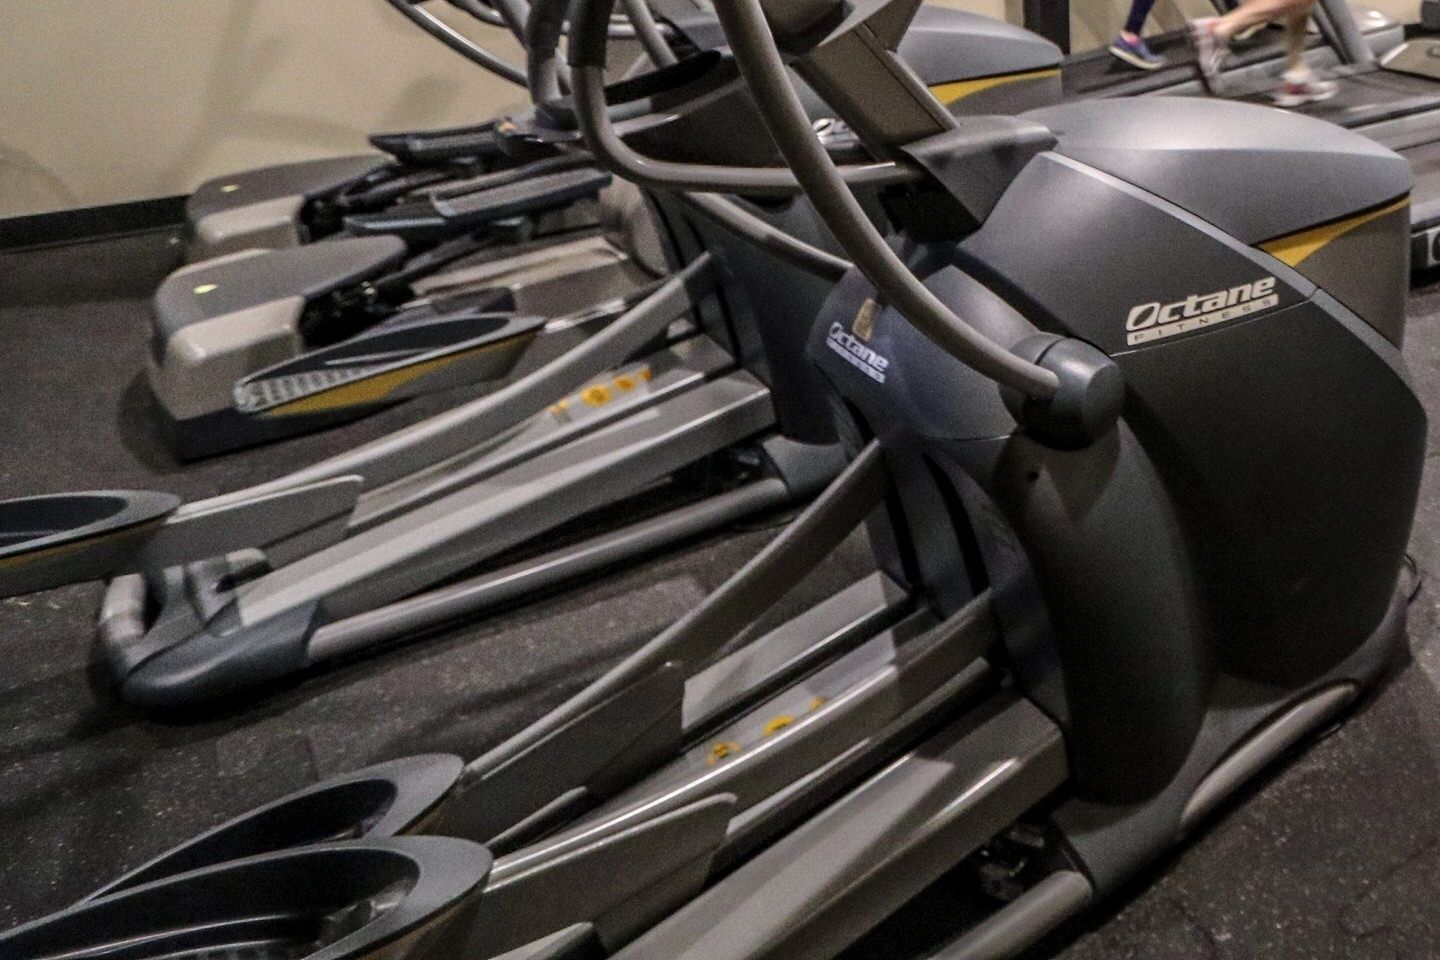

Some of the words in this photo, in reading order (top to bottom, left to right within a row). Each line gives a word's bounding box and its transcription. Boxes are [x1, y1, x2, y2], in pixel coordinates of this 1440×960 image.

[1125, 276, 1276, 331] Octane
[1131, 297, 1274, 343] FITNESS
[828, 321, 889, 373] Octane
